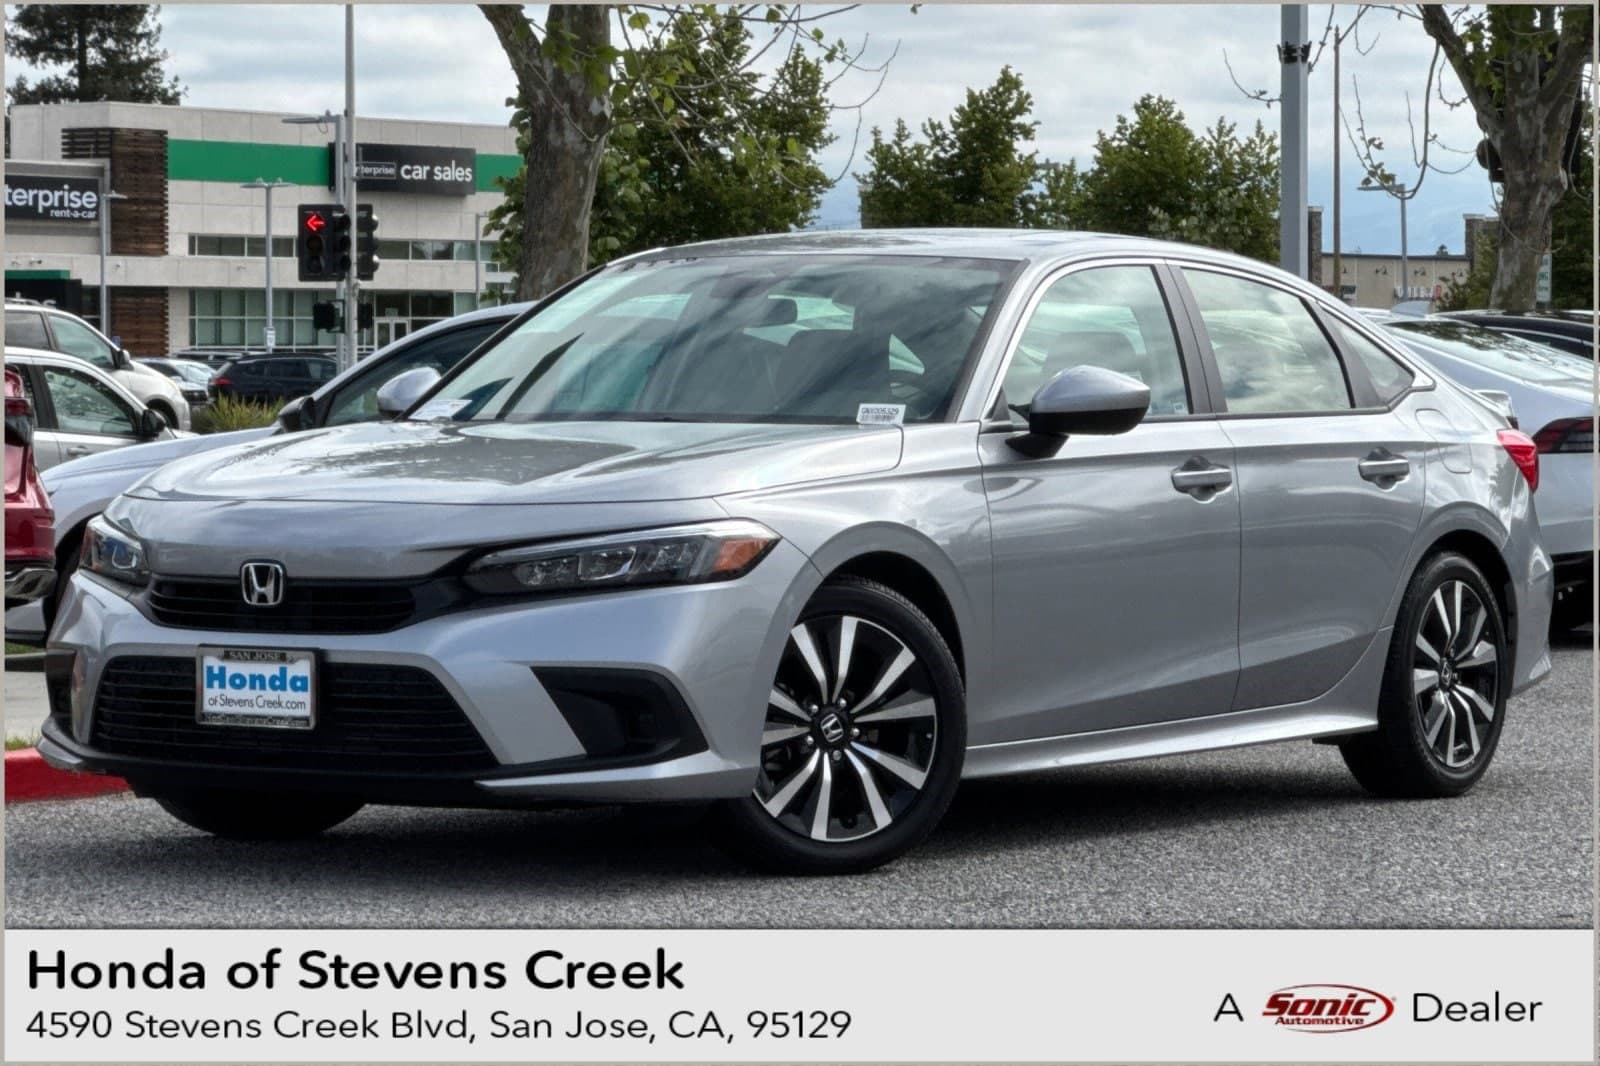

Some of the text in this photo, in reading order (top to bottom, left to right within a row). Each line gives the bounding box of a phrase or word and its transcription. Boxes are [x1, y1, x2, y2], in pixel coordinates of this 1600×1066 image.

[401, 164, 430, 179] car
[433, 160, 472, 182] sales
[50, 209, 96, 219] rent-a-car
[206, 665, 309, 693] Honda
[208, 694, 306, 711] of Stevens Creek.com
